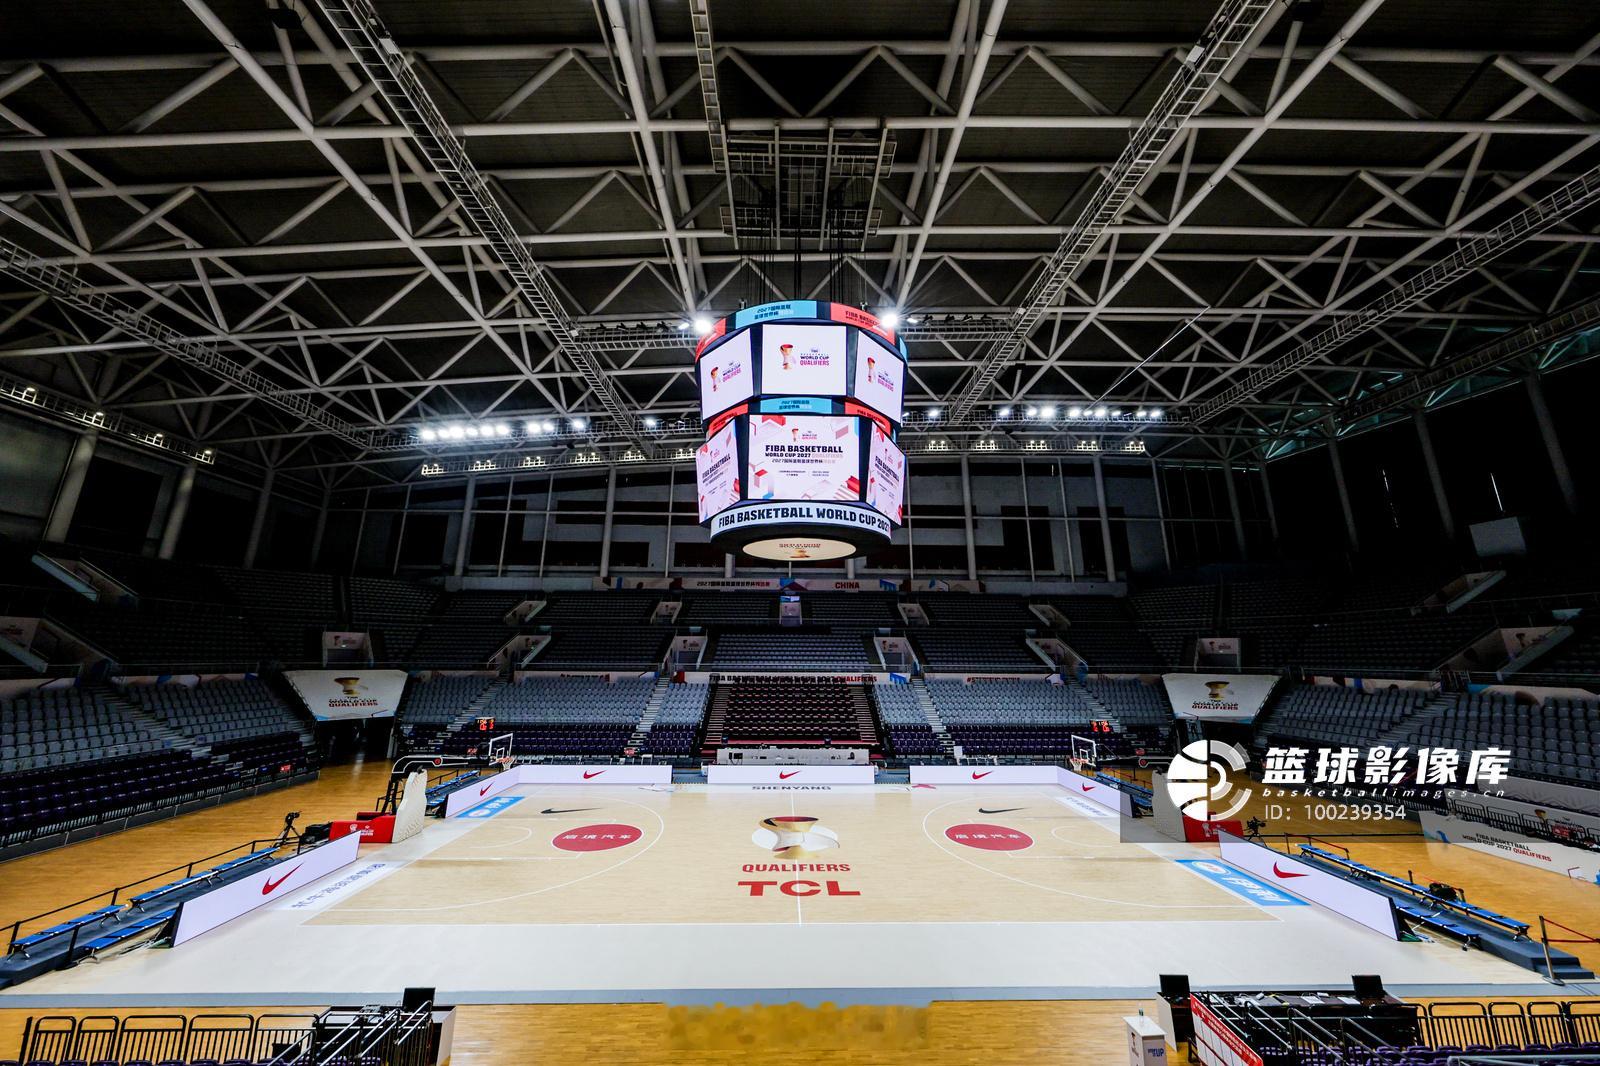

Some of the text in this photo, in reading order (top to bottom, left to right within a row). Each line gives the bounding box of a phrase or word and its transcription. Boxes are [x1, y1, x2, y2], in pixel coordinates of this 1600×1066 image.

[765, 444, 844, 453] FIBA BASKETBALL
[718, 507, 890, 531] FIBA BASKETBALL WORLD CUP 2027
[834, 581, 860, 589] CHINA
[1462, 834, 1482, 844] WORLD
[1496, 843, 1512, 851] 2027
[1512, 847, 1552, 862] QUALIFIERS
[1475, 832, 1531, 851] FIBA BASKETBALL
[741, 863, 851, 873] QUALIFIERS
[737, 880, 861, 897] TCL
